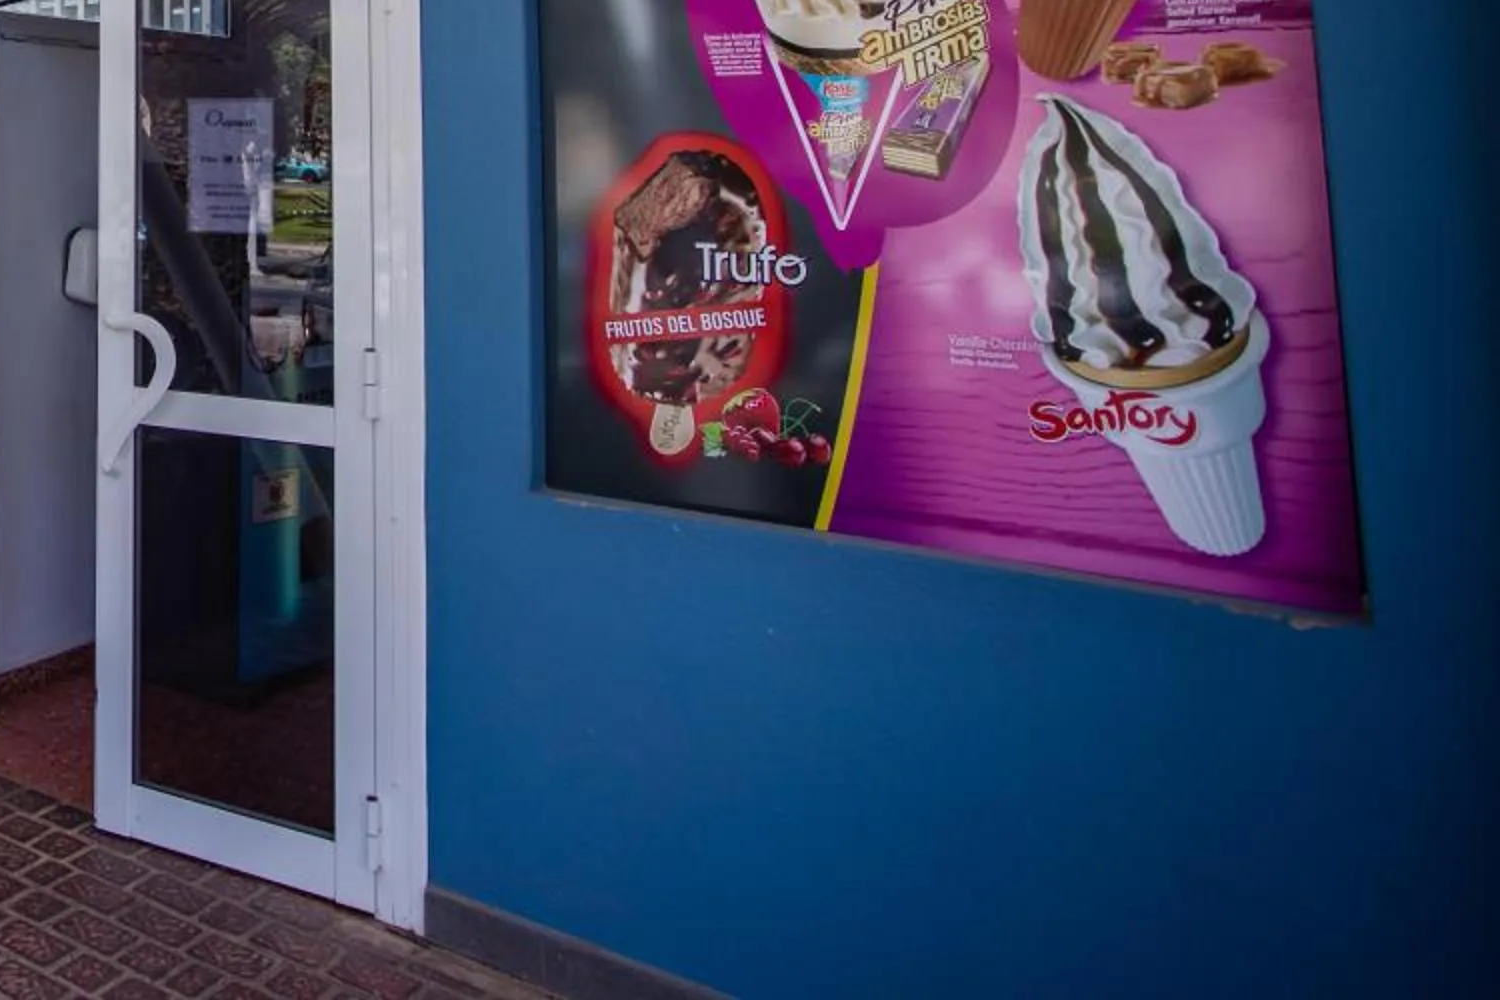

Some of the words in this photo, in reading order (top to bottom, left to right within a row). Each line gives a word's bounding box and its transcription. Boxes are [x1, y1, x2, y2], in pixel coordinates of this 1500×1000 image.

[694, 241, 808, 286] Trufo
[604, 316, 664, 339] FRUTOS
[667, 313, 699, 334] DEL
[701, 307, 767, 332] BOSQUE
[1027, 389, 1199, 447] Santory
